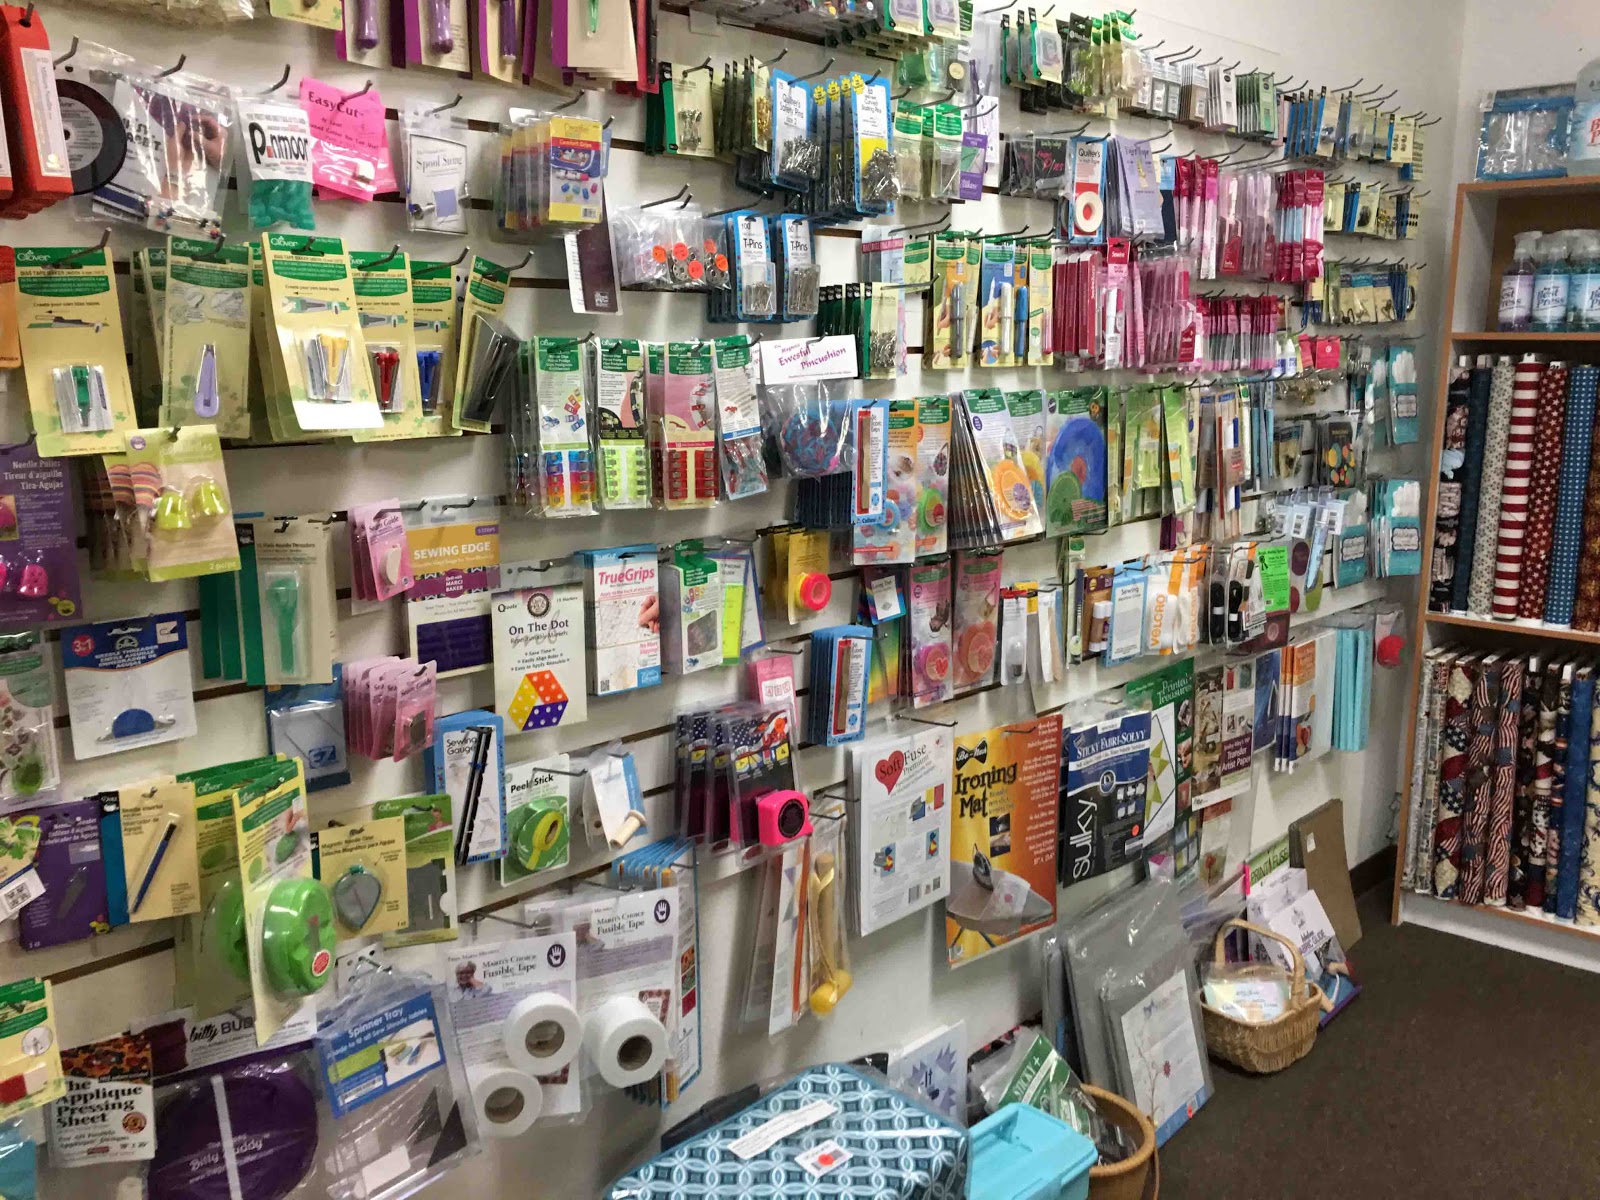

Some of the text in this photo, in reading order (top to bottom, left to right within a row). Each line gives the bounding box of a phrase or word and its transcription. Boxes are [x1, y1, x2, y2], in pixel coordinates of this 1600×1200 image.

[173, 240, 203, 252] Clover
[271, 235, 298, 247] Clover
[743, 238, 763, 250] T-Pins
[790, 241, 808, 252] T-Pins
[17, 249, 51, 262] Clover
[1501, 289, 1515, 299] est
[1537, 286, 1558, 299] Best
[1501, 298, 1520, 307] ress
[800, 347, 847, 369] Pincushion
[12, 460, 38, 469] Needle
[20, 481, 64, 491] Tira-Agujas
[383, 515, 399, 527] Guide
[414, 541, 491, 560] SEWING EDGE
[598, 567, 655, 586] TrueGrips
[509, 619, 569, 636] On The Dot
[1162, 674, 1188, 693] Printed
[904, 744, 927, 765] Fuse
[879, 757, 901, 780] Soft
[510, 774, 554, 793] Peel Stick
[955, 762, 1017, 795] Ironing
[959, 788, 988, 818] Mat
[467, 854, 489, 863] ollins
[596, 919, 645, 936] Fusible Tape
[483, 962, 537, 979] Fusible Tape
[347, 1007, 404, 1039] Spinner Tray
[66, 1080, 92, 1092] he
[56, 1086, 142, 1106] Applique
[57, 1100, 135, 1117] Pressing
[56, 1112, 107, 1128] Sheet
[234, 1138, 263, 1155] uddy
